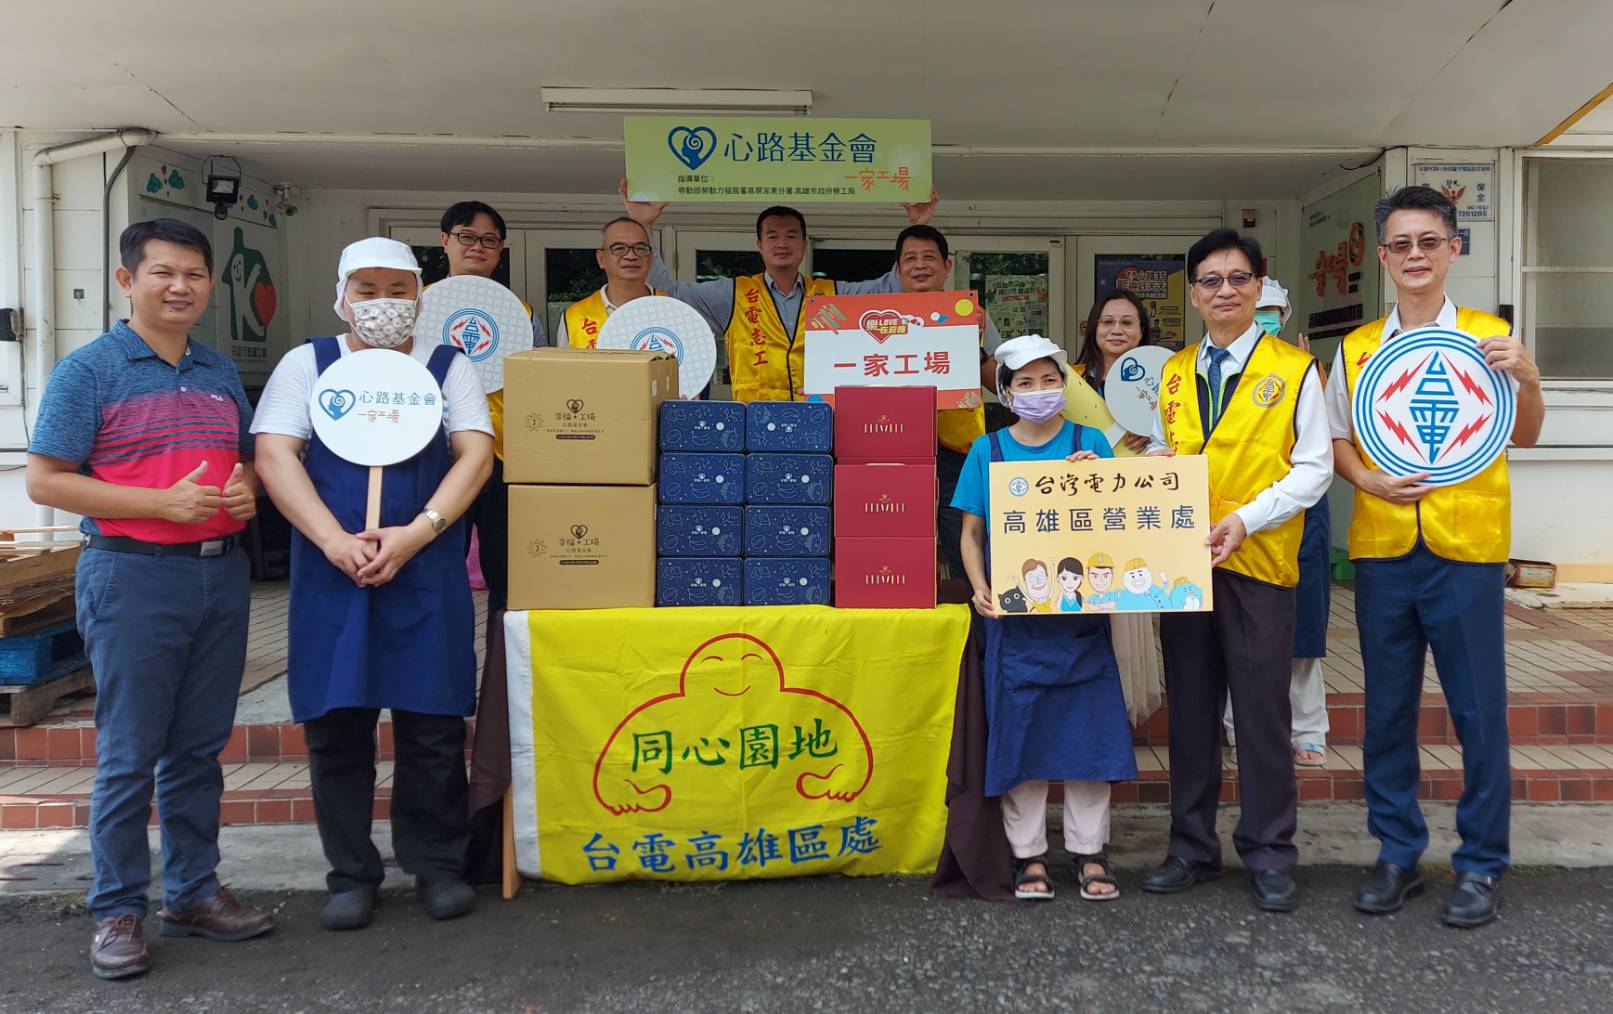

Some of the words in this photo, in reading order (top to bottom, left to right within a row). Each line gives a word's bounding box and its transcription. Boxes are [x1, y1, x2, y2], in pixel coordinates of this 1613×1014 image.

[723, 132, 877, 163] 心路基金會
[843, 166, 911, 193] 一家工場
[745, 288, 768, 366] 台電志工
[834, 351, 951, 377] 一家工場
[360, 391, 436, 406] 心路基金會
[1003, 504, 1195, 534] 高雄區營業處
[632, 718, 838, 775] 同心園地
[582, 816, 884, 873] 台電高雄區處
